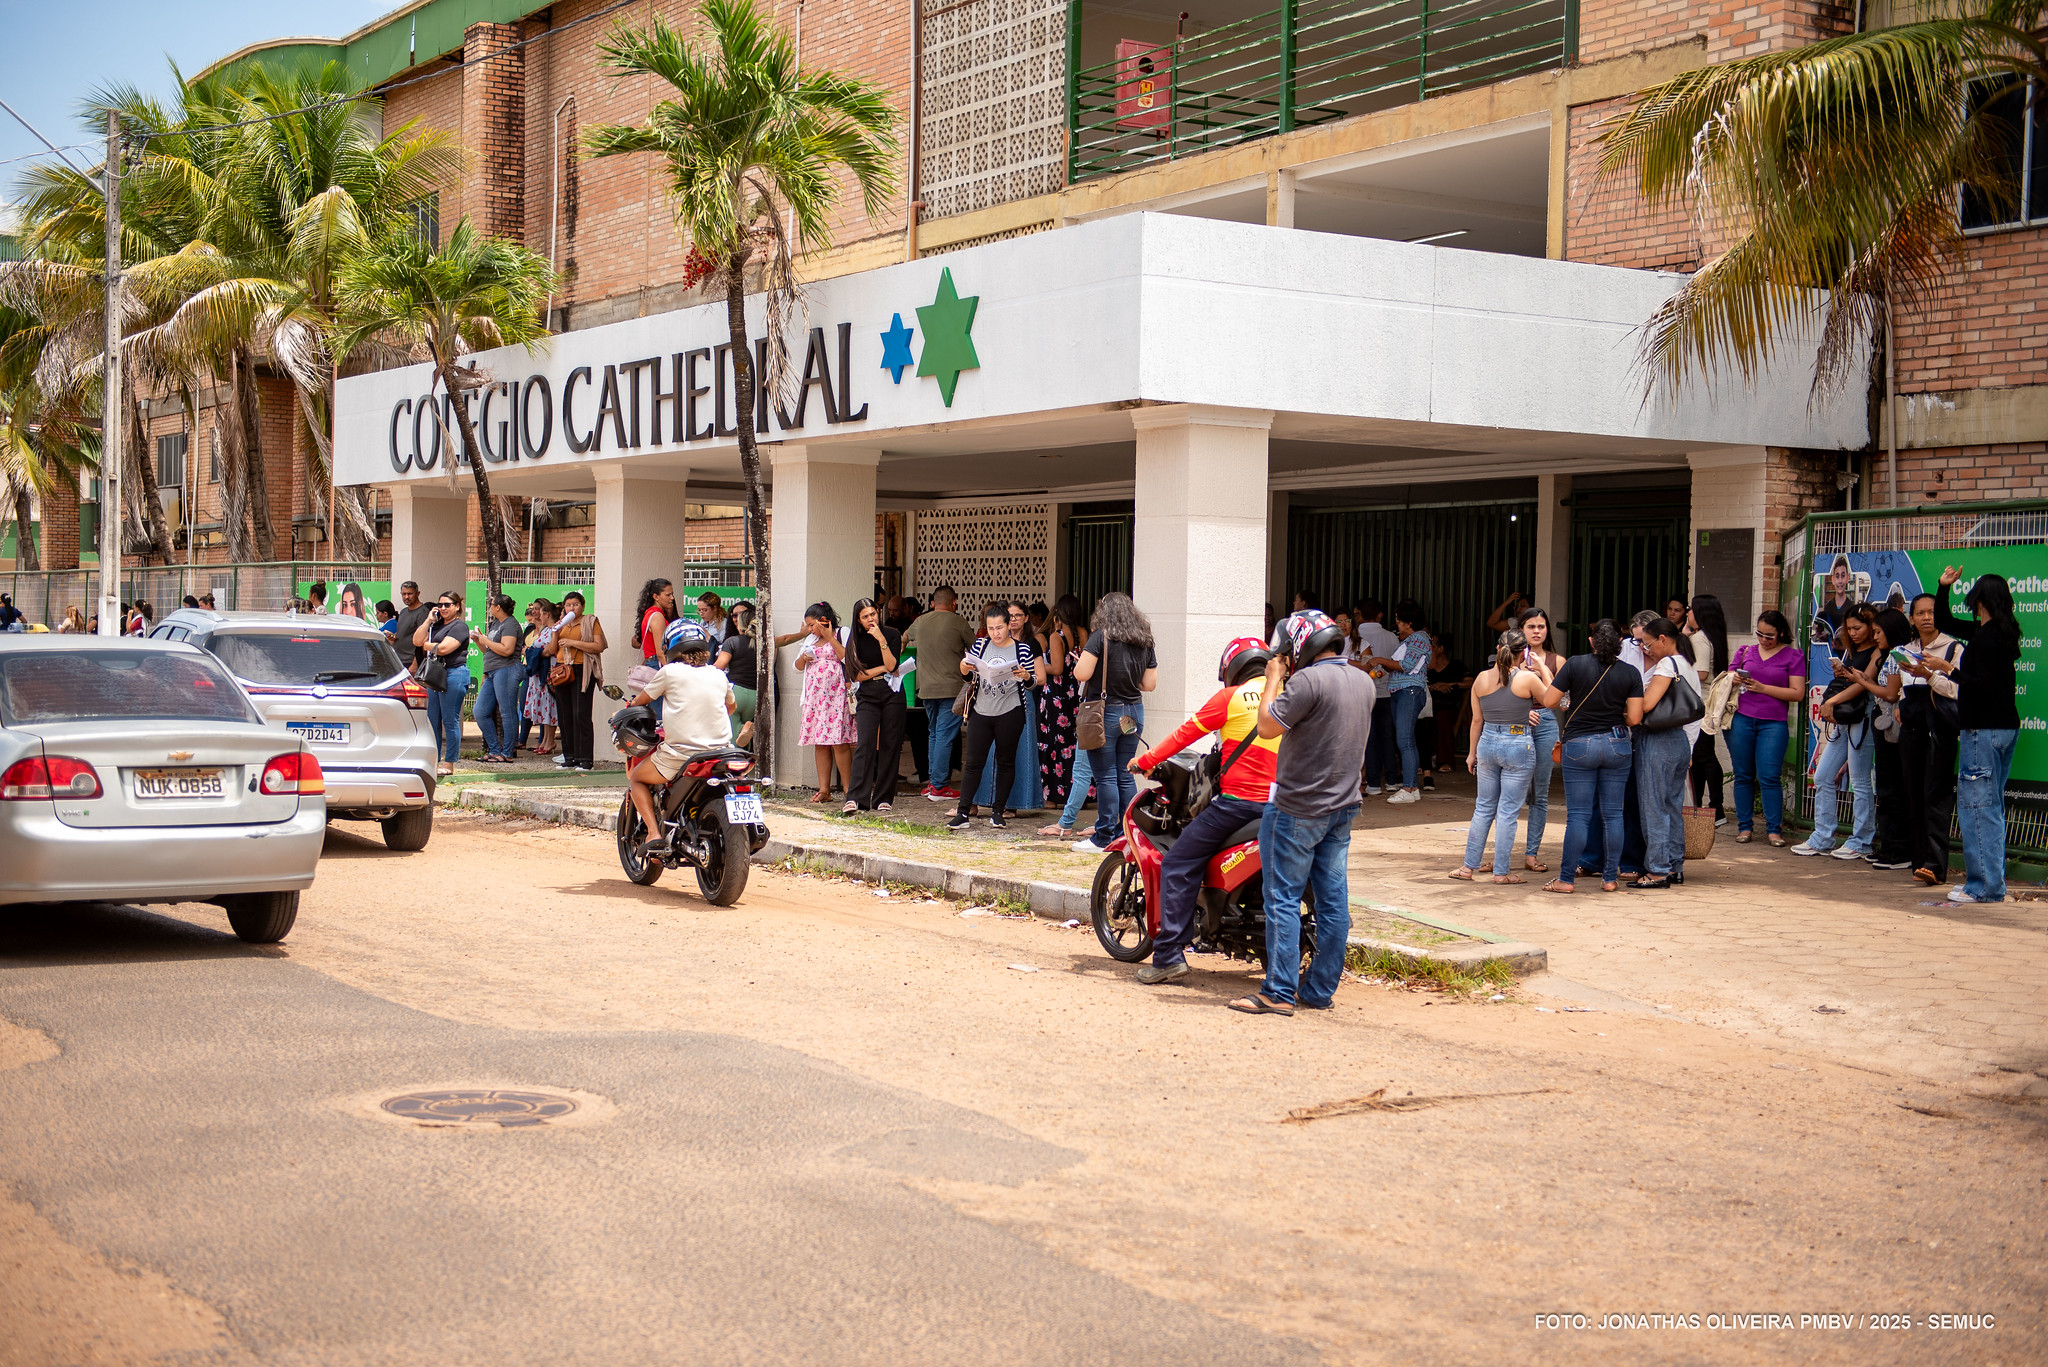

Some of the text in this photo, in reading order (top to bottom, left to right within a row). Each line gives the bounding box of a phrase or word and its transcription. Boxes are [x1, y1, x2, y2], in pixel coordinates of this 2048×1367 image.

[563, 322, 869, 454] CATHEDRAL
[2018, 600, 2048, 612] transf
[2020, 716, 2047, 730] rfeito
[734, 800, 754, 810] RZC
[733, 811, 760, 821] 5J74
